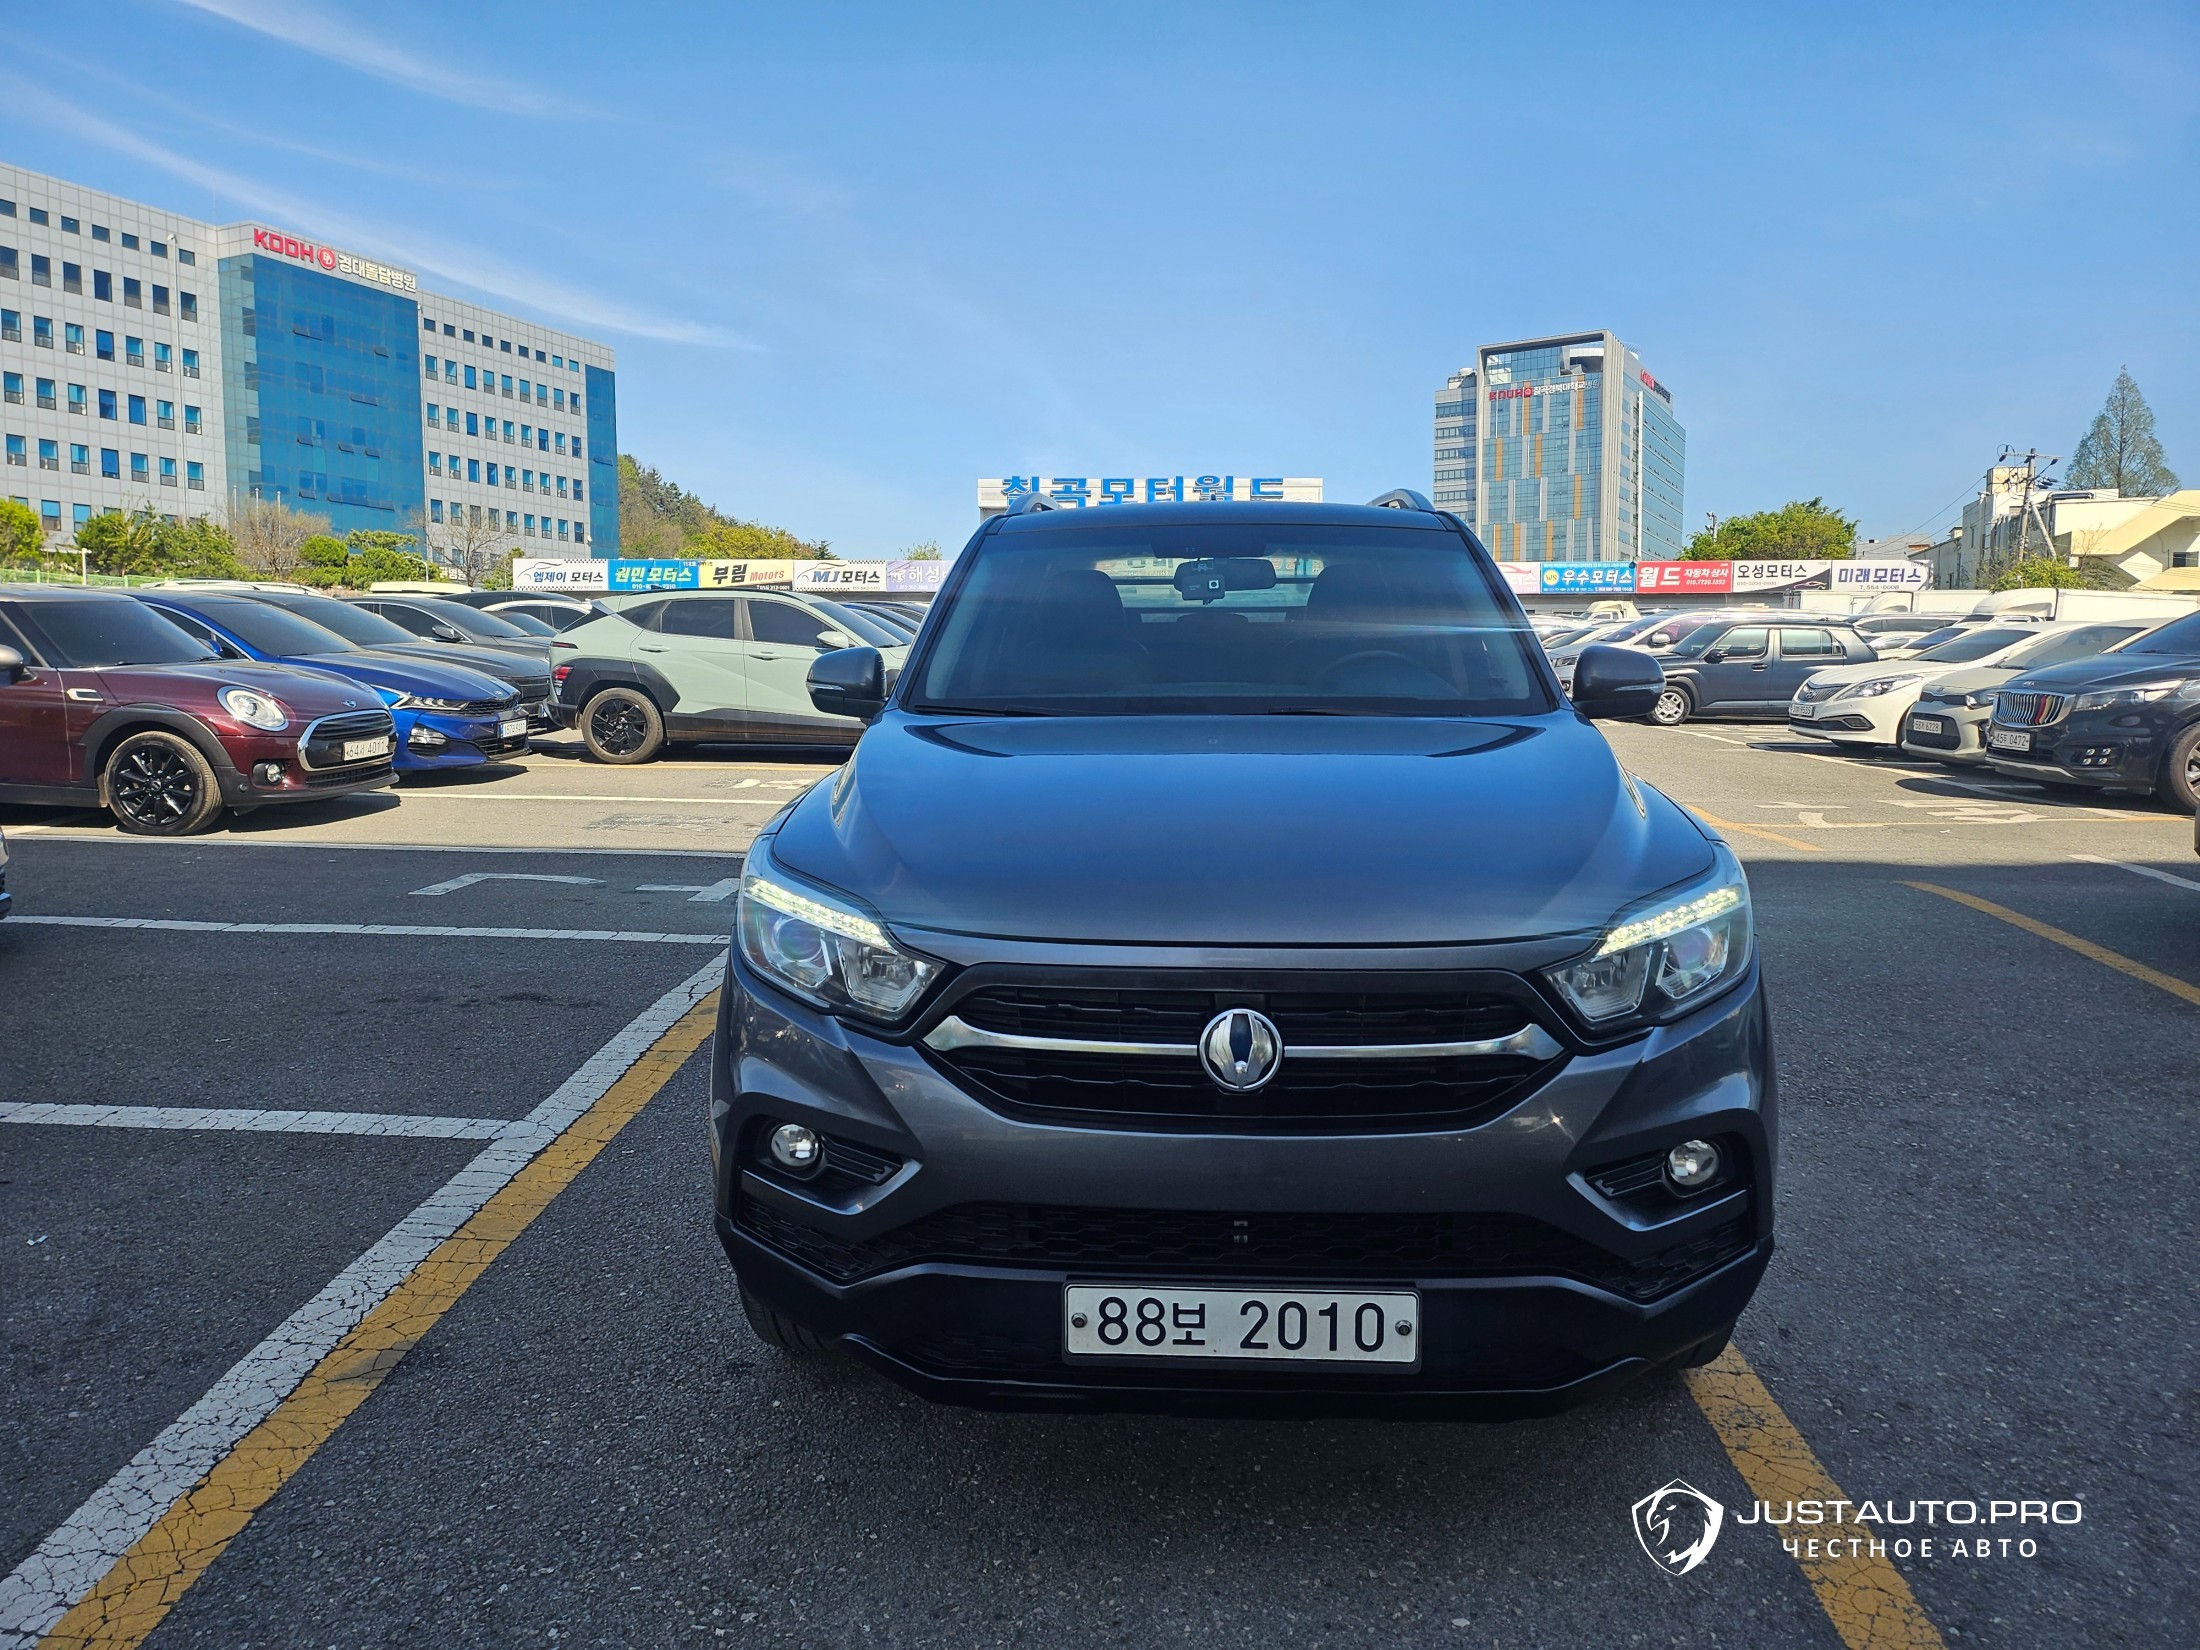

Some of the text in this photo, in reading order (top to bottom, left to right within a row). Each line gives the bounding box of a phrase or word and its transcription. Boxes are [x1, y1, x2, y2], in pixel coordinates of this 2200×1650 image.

[338, 254, 417, 293] 경대돌담병원
[533, 571, 604, 583] 엠제이 모터스
[713, 564, 785, 584] 부림 Motors
[909, 566, 947, 583] 해성
[1562, 569, 1632, 585] 우수모터스
[1639, 567, 1681, 588] 월드
[1684, 568, 1710, 578] 자동차
[1737, 564, 1807, 579] 오성모터스
[2009, 734, 2027, 746] 0472
[1098, 1296, 1386, 1352] 88보 2010
